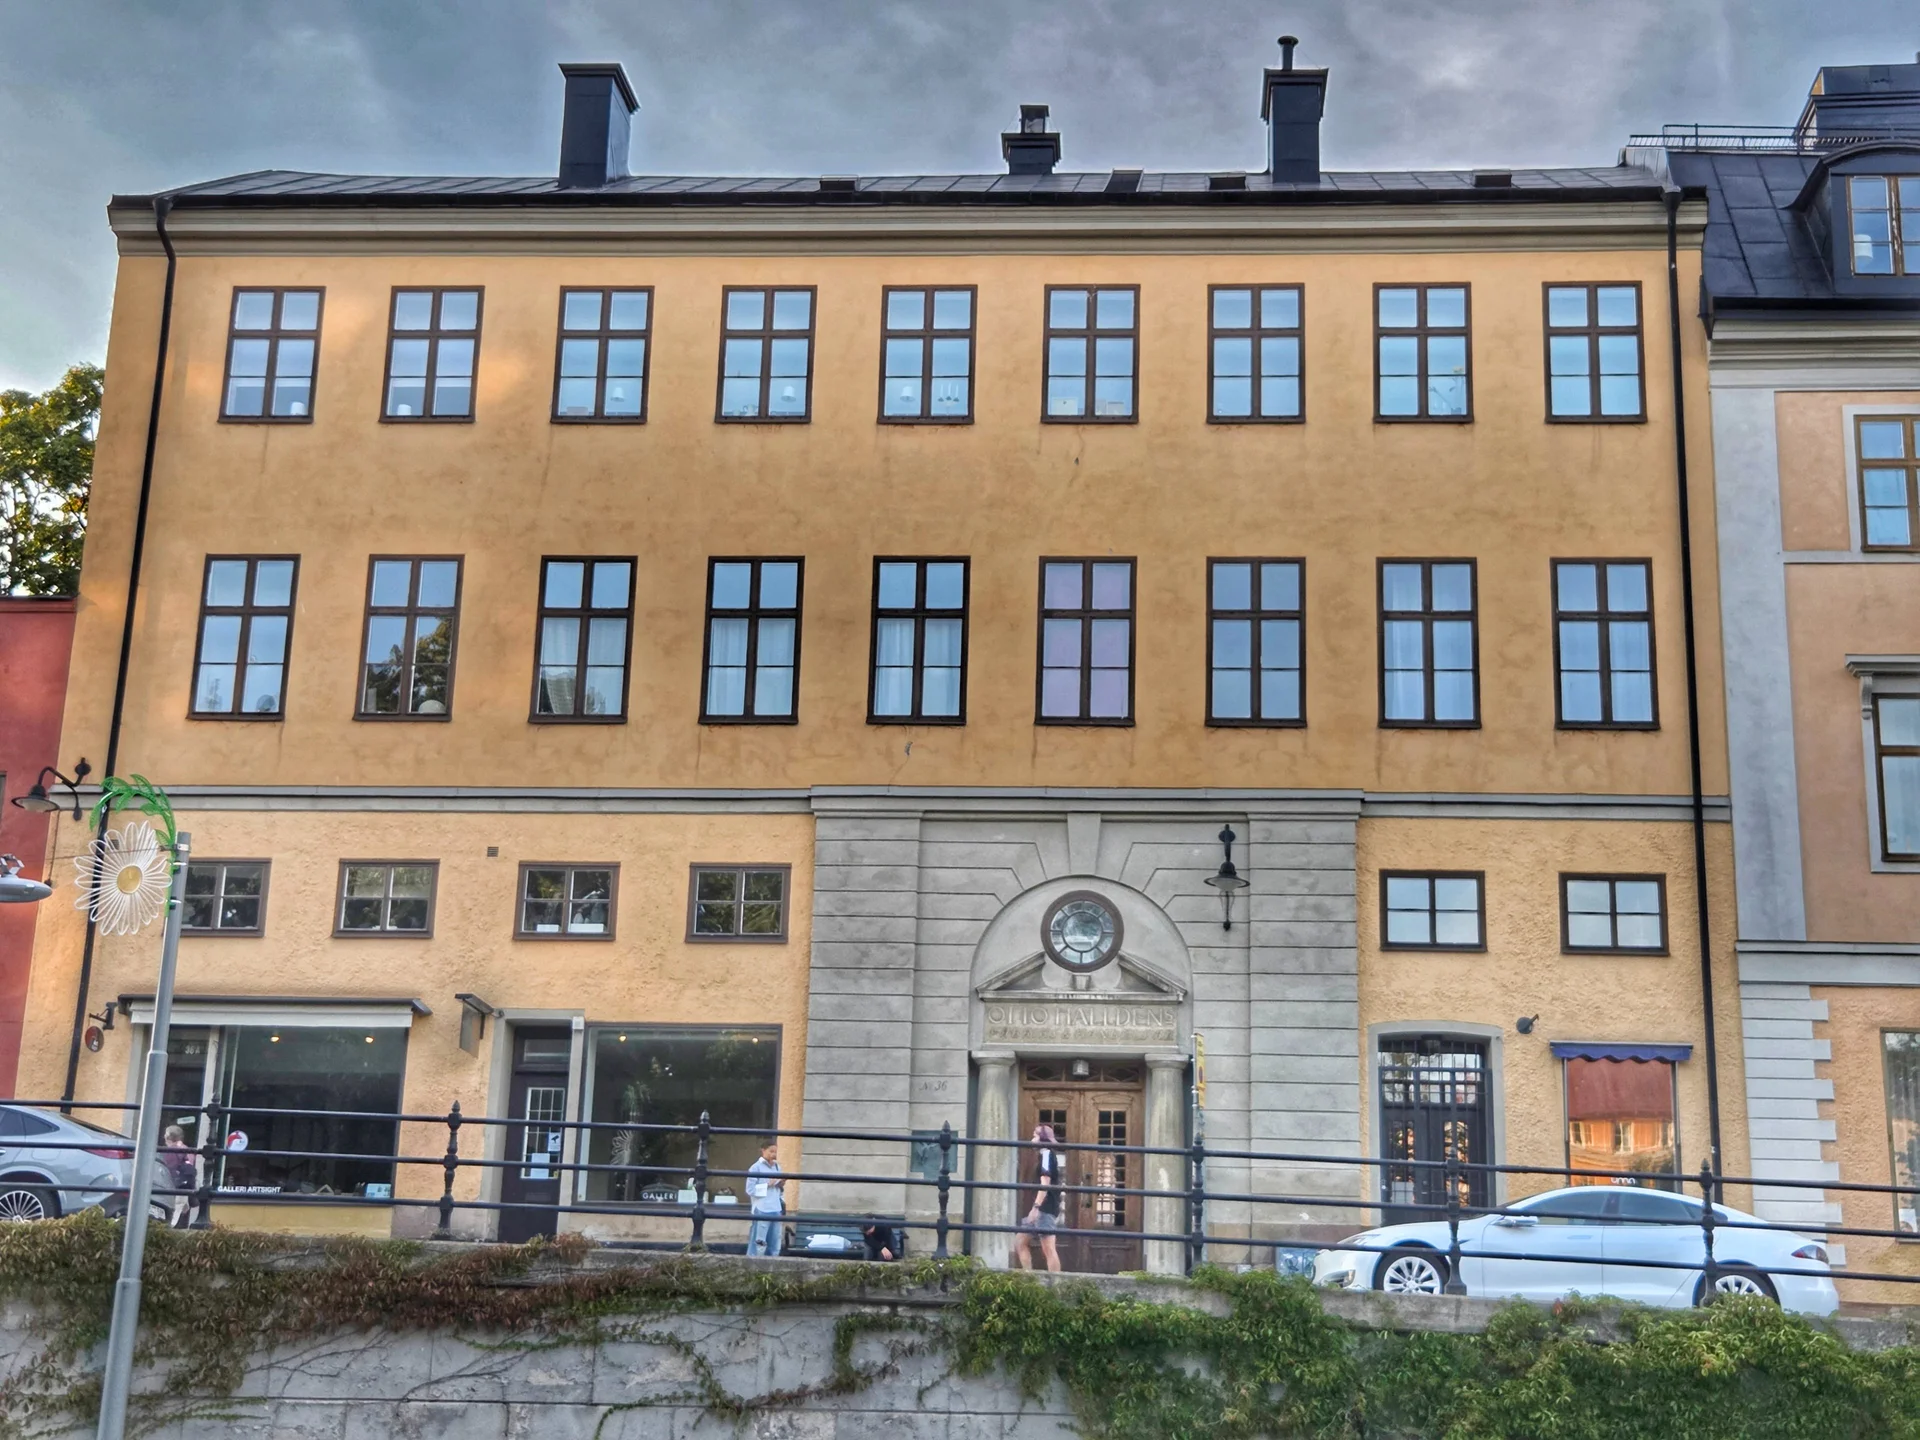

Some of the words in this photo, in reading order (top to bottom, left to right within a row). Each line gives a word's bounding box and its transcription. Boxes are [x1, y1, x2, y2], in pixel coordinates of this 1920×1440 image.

[988, 1006, 1048, 1025] OTTO
[934, 1080, 948, 1091] 36
[642, 1192, 677, 1200] GALLERI
